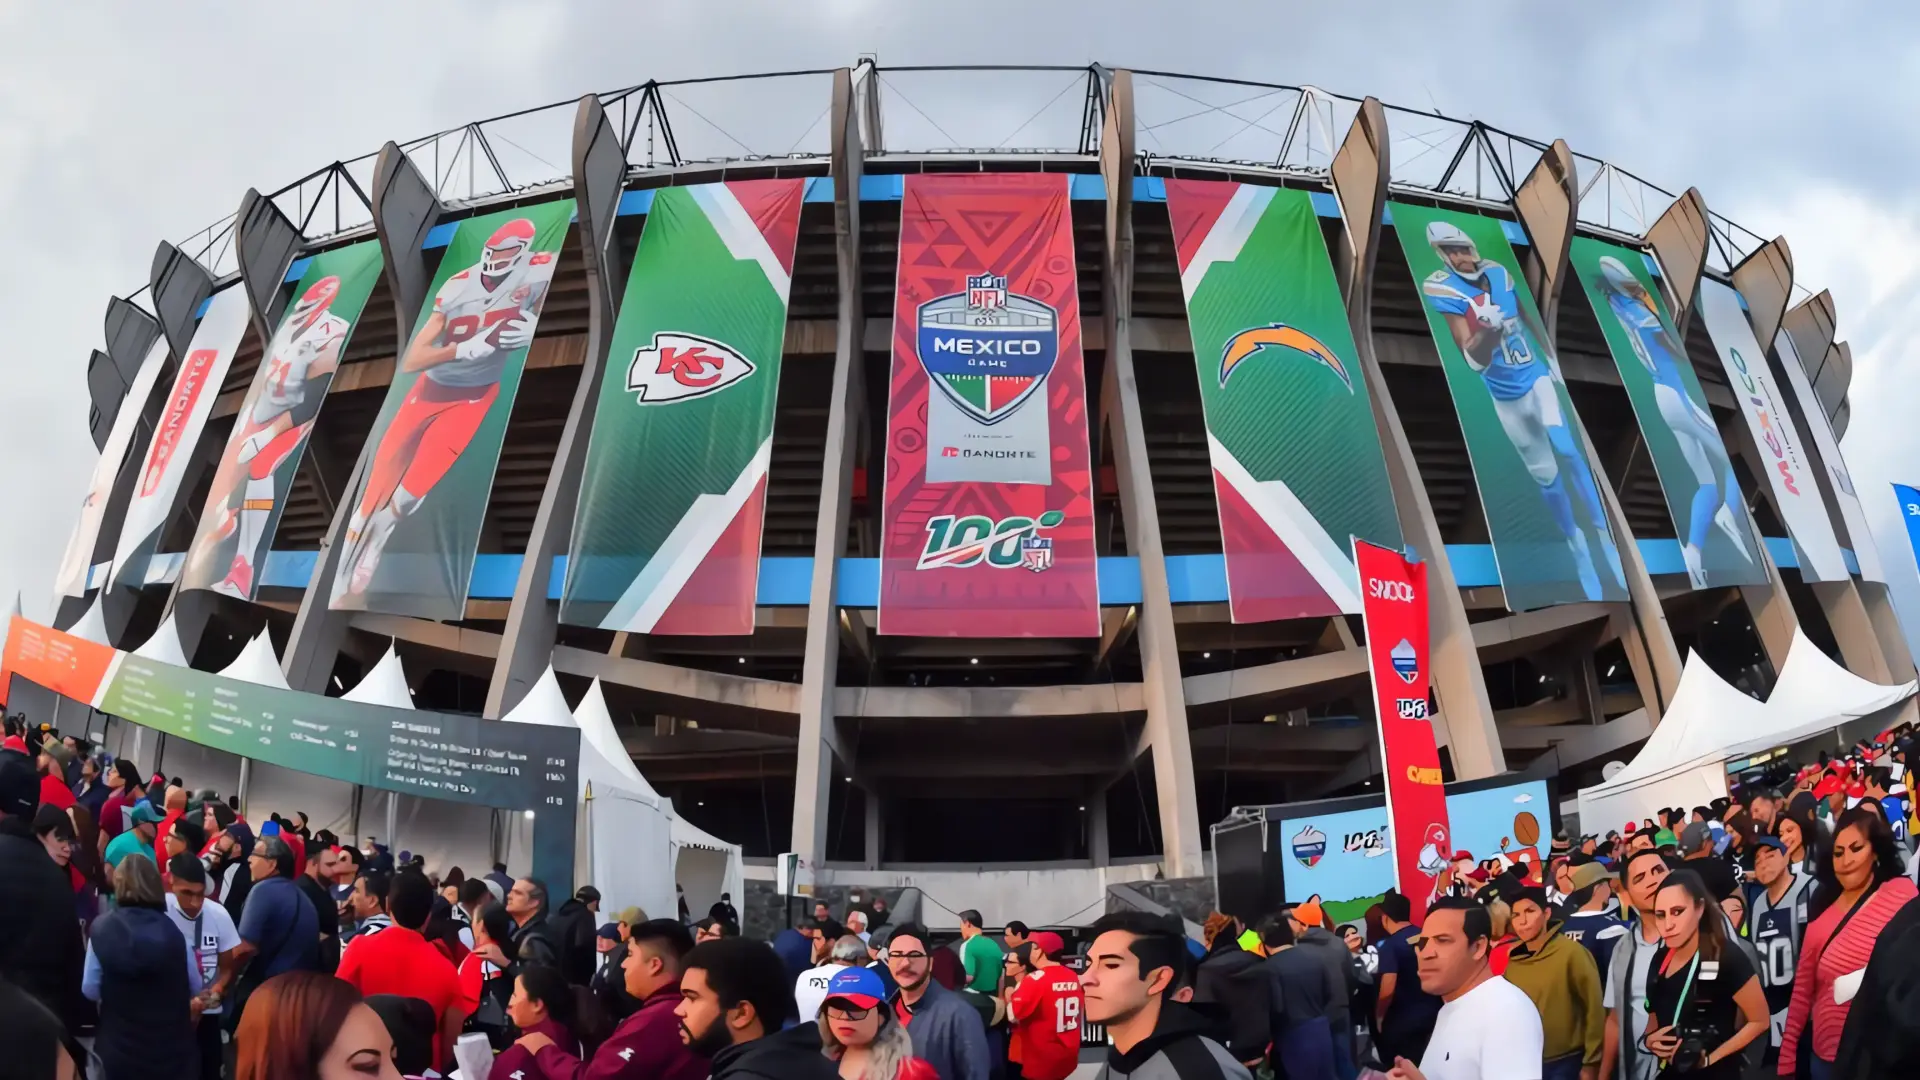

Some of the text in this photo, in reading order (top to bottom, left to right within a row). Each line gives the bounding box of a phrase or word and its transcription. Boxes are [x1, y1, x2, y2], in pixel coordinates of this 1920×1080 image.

[934, 337, 1041, 355] MEXICO
[655, 347, 724, 387] KC
[963, 449, 1037, 459] BANORTE
[916, 514, 1036, 570] 100
